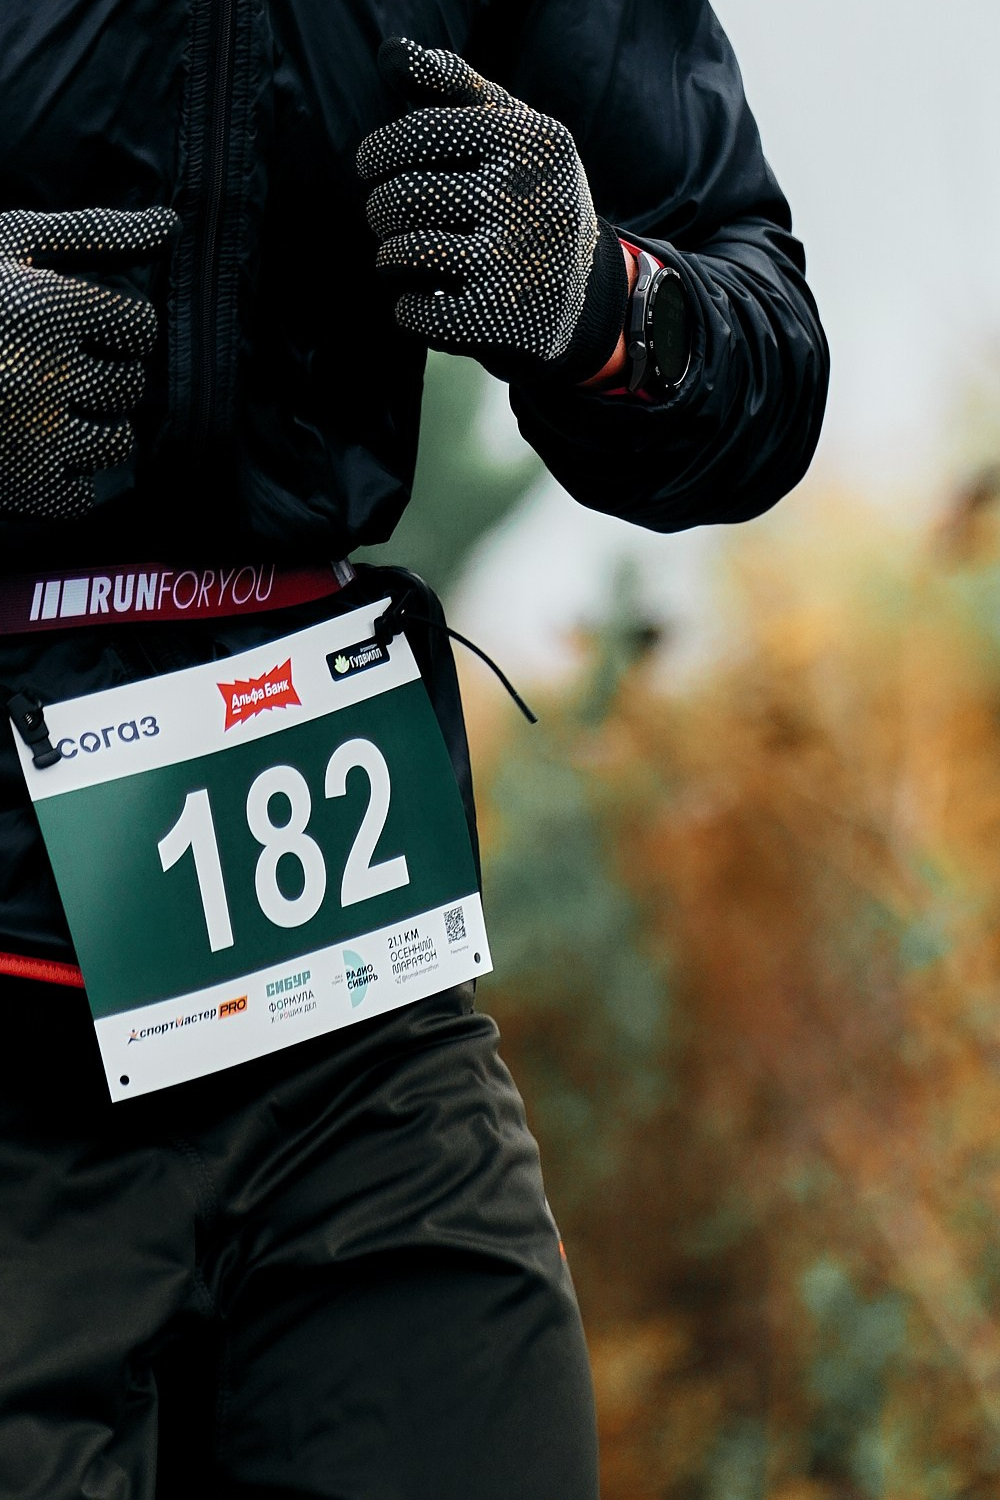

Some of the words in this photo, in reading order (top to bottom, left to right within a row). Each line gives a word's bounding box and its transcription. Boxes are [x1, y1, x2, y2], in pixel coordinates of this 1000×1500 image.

[231, 688, 265, 710] Альфа
[264, 679, 290, 698] Банк
[157, 738, 410, 953] 182
[387, 932, 403, 949] 21.1
[390, 936, 434, 962] ОСЕННИЙ
[346, 964, 374, 981] РАДИО
[391, 951, 438, 975] МАРАФОН
[266, 970, 311, 997] СИБУР
[347, 973, 379, 990] СИБИРЬ
[219, 999, 246, 1017] PRO
[268, 990, 315, 1013] ФОРМУЛА
